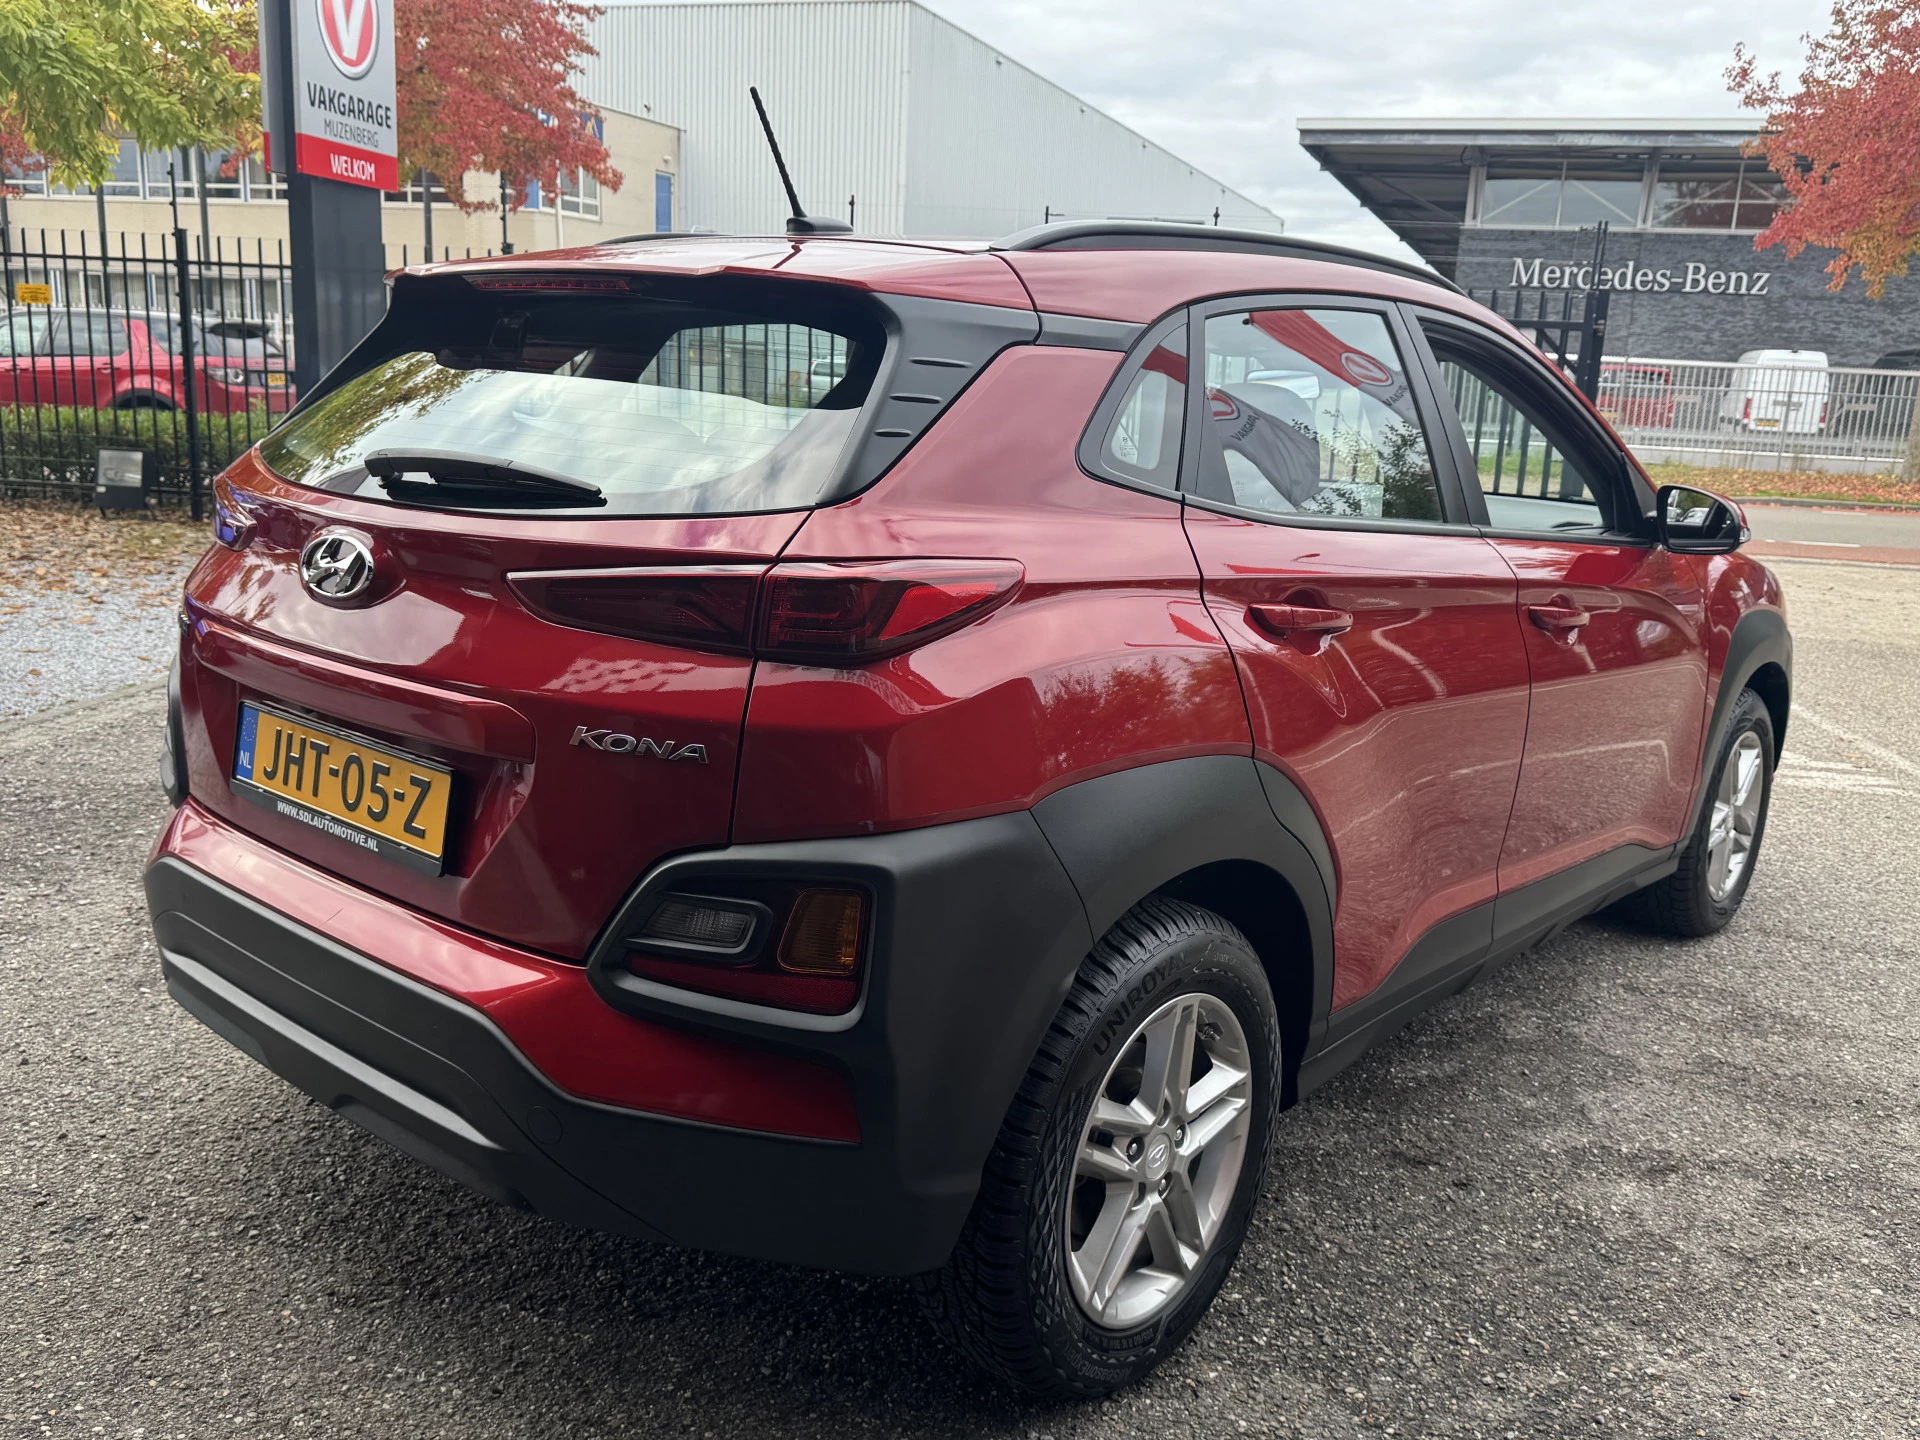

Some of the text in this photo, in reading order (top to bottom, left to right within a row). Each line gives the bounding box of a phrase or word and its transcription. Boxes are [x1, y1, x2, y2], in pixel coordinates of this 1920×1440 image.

[306, 81, 393, 129] VAKGARAGE
[323, 117, 380, 149] MUZENBERG
[329, 153, 376, 183] WELKOM
[1508, 256, 1772, 296] Mercedes-Benz
[239, 750, 252, 769] NL
[569, 725, 709, 764] KONA
[263, 726, 432, 840] JHT-05-Z
[276, 800, 379, 852] WWW.SDLAUTOMOTIVE.NL
[1093, 951, 1192, 1056] UNIROYAL
